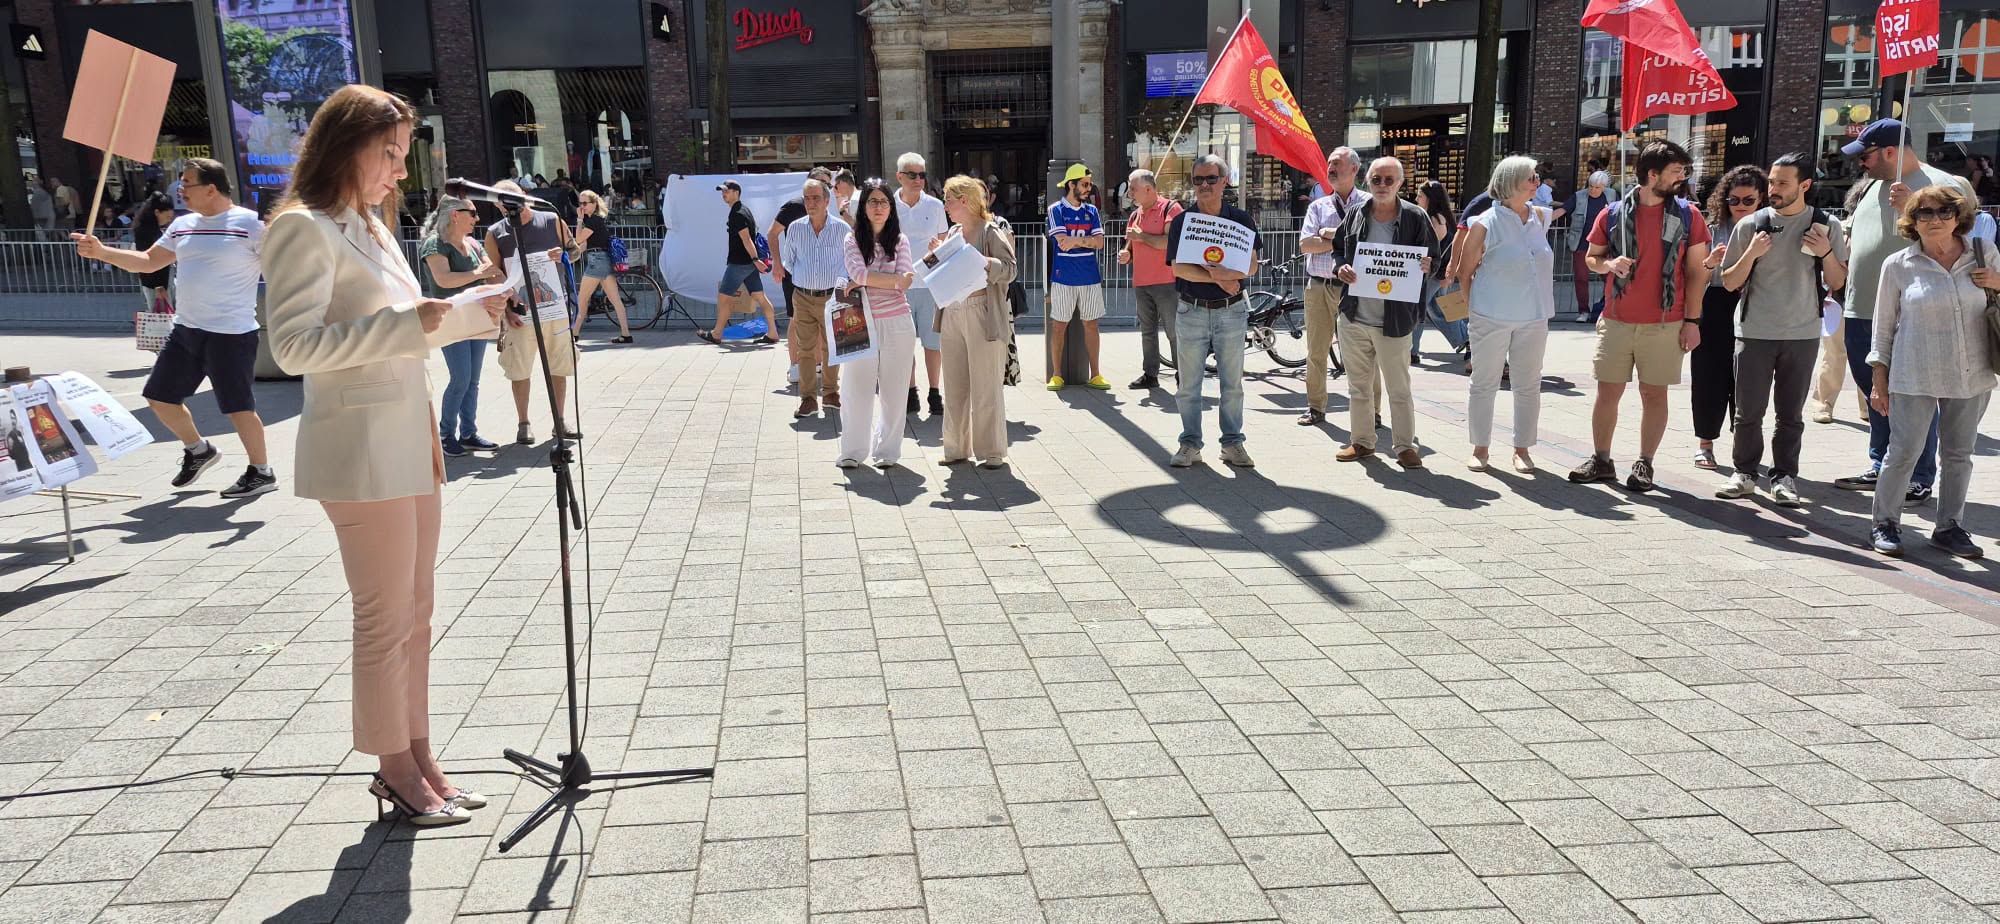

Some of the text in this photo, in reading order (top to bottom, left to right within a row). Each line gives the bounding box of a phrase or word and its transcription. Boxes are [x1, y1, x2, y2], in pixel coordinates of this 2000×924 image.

[733, 6, 805, 45] Ditsch
[1176, 60, 1206, 74] 50%
[1270, 78, 1303, 118] DID
[1190, 217, 1217, 227] Sanat
[1358, 248, 1384, 257] DENİZ
[1372, 258, 1405, 269] YALNIZ
